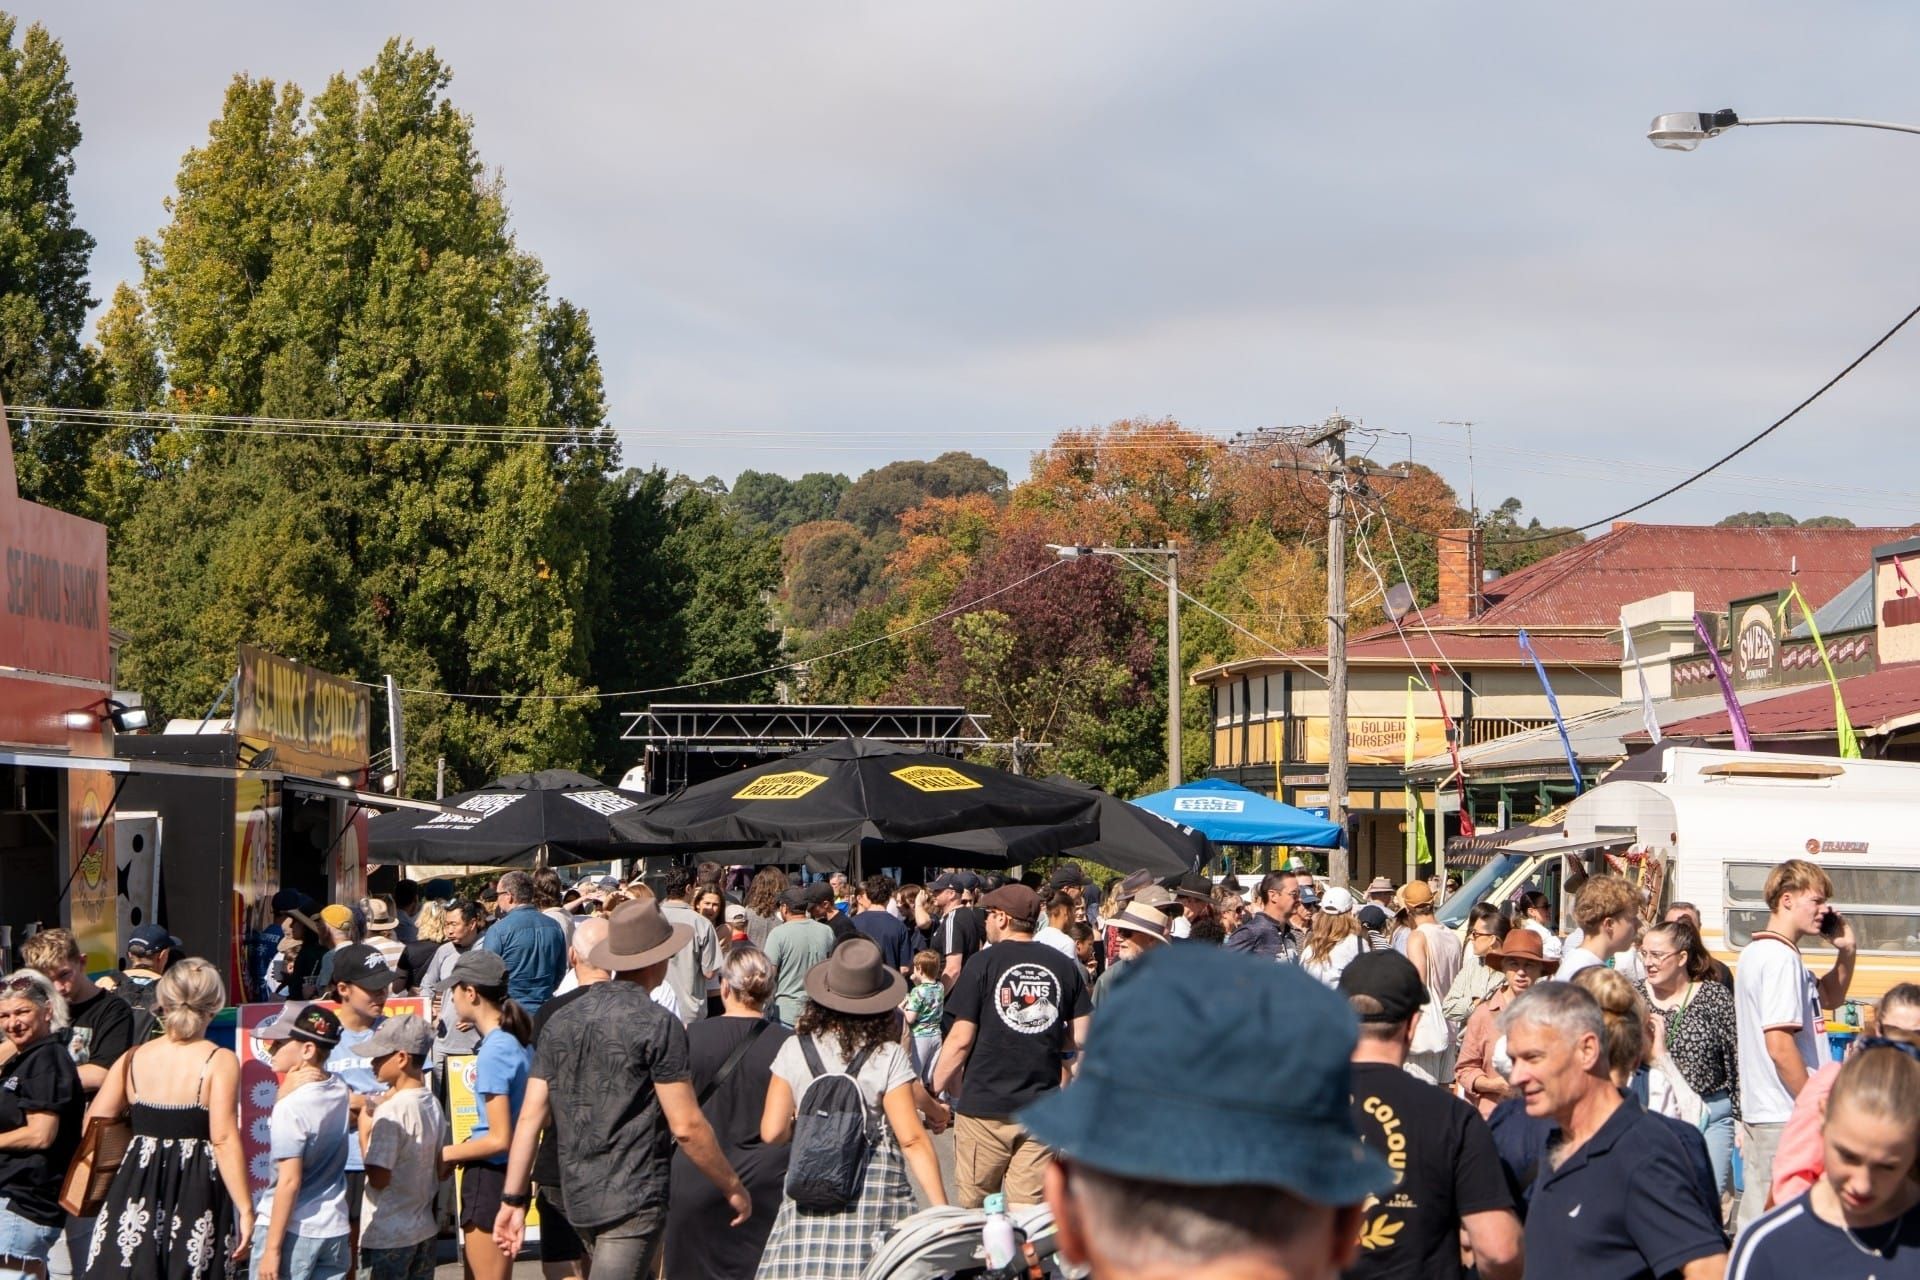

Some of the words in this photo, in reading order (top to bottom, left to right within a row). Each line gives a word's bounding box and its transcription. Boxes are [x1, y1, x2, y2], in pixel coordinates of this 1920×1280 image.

[7, 545, 60, 623] SEAFOOD
[64, 561, 99, 632] SHACK
[1740, 625, 1774, 673] SWEET
[256, 658, 307, 743] SLINKY
[315, 678, 357, 755] SPUDZ
[1361, 720, 1406, 734] GOLDEN
[1347, 732, 1420, 748] HORSESHOS
[741, 783, 784, 796] PALE
[770, 784, 809, 796] ALE
[911, 776, 953, 789] PALE
[943, 776, 976, 787] ALE
[1009, 981, 1051, 997] VANS
